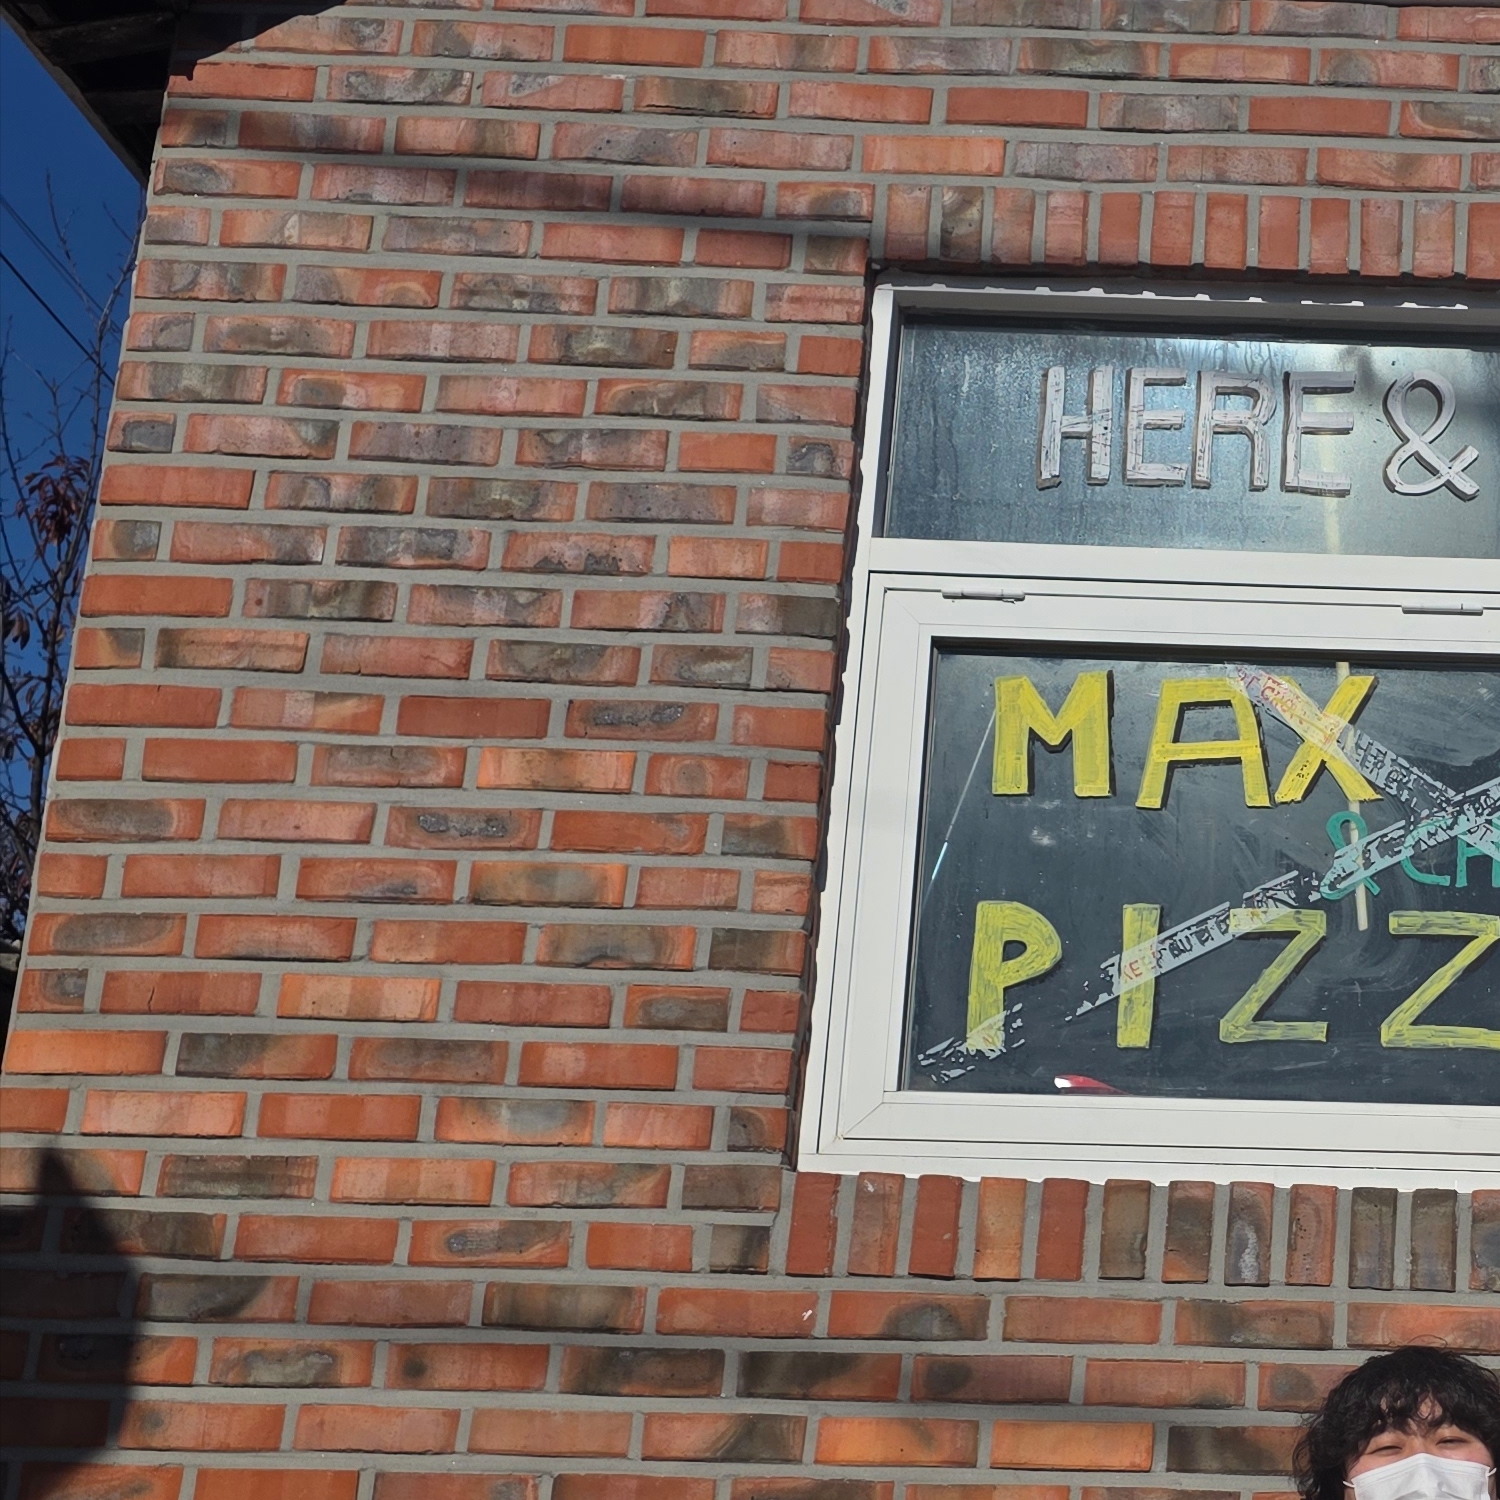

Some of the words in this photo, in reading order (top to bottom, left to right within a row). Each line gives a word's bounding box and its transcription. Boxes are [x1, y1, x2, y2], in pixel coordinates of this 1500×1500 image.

[1036, 366, 1356, 497] HERE
[1383, 369, 1480, 502] &
[991, 670, 1384, 809] MAX
